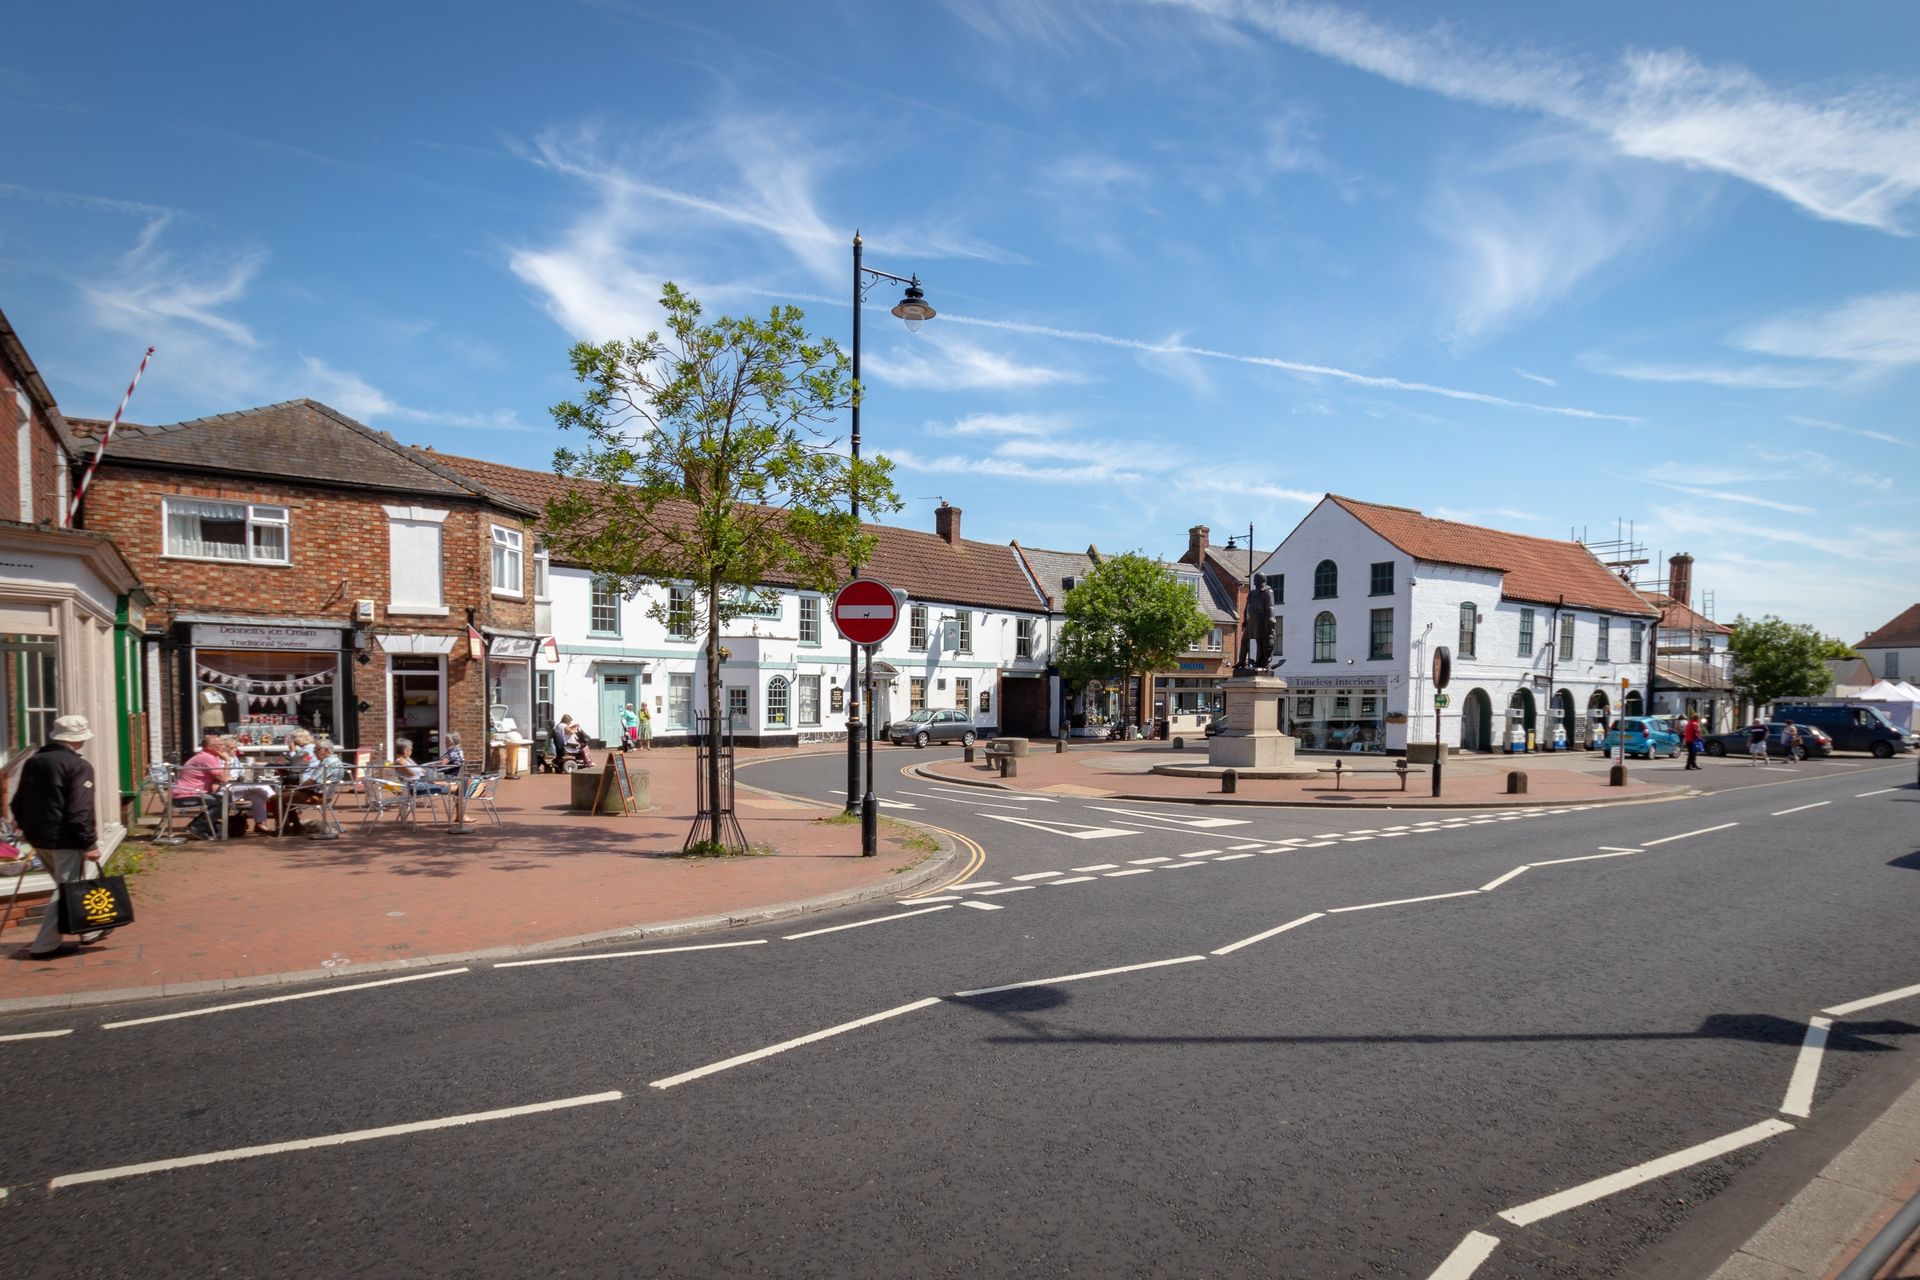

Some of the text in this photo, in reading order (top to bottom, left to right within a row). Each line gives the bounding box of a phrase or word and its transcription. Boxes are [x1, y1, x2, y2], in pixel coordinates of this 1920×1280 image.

[285, 629, 316, 637] Cream
[230, 639, 275, 647] Traditional
[1296, 678, 1376, 686] Timeless Interiors
